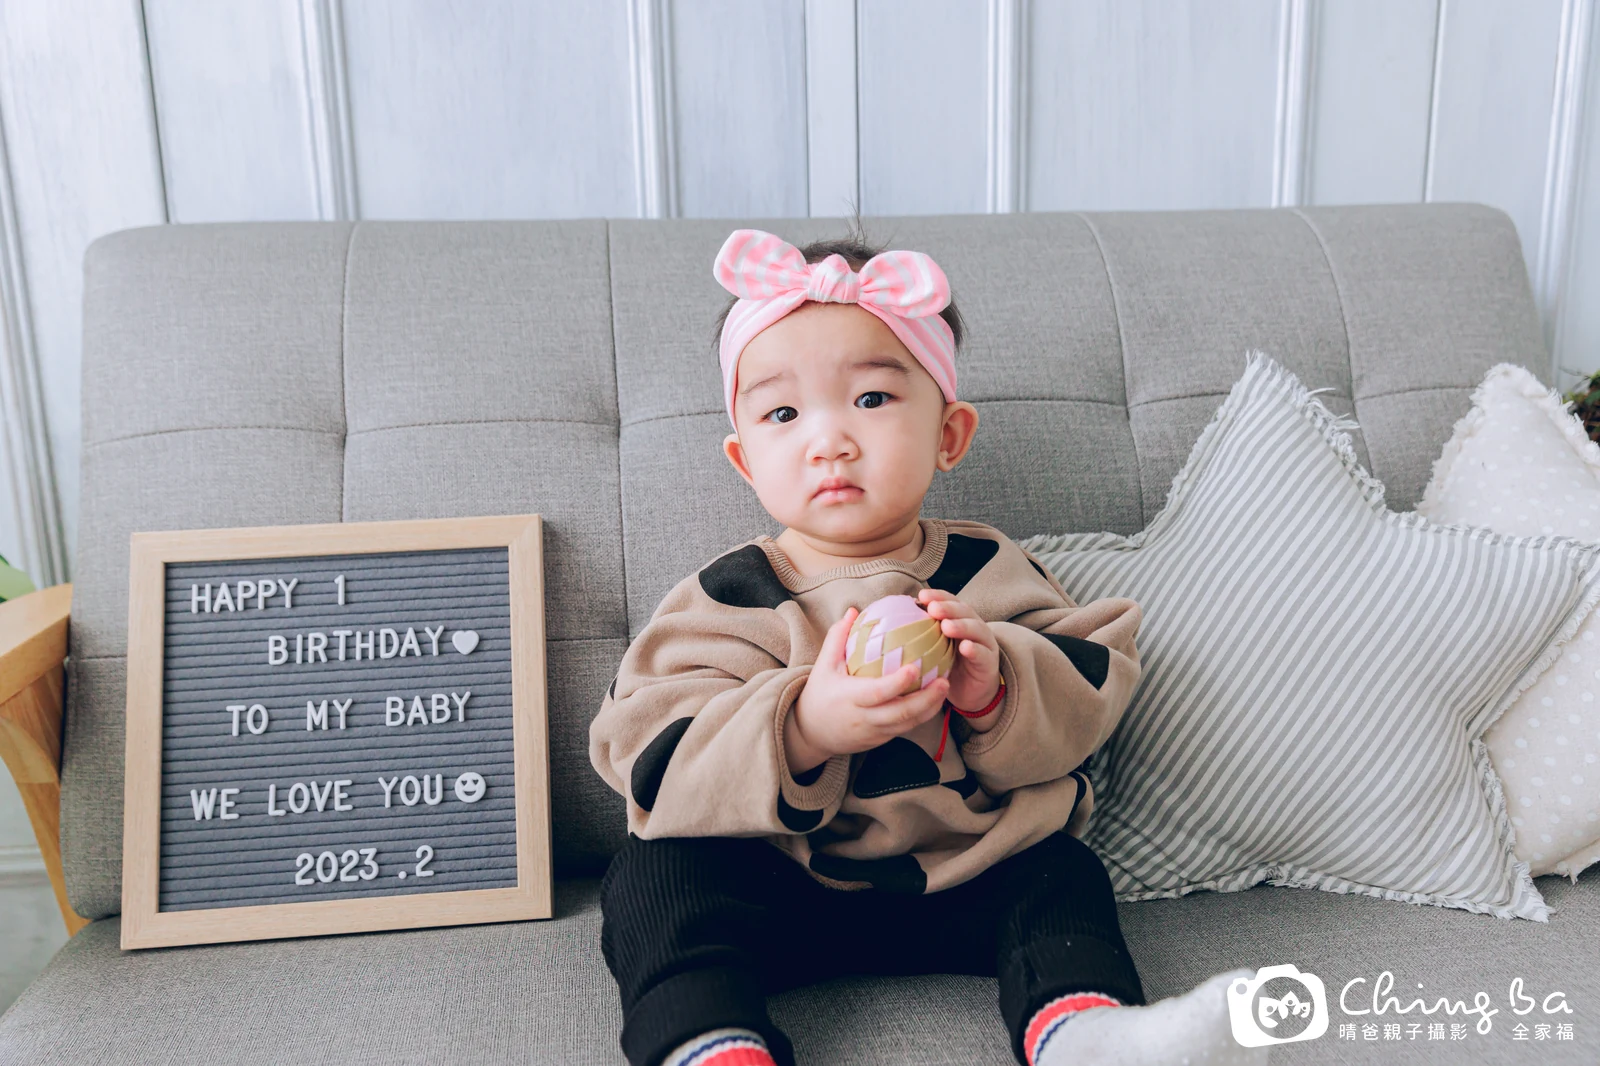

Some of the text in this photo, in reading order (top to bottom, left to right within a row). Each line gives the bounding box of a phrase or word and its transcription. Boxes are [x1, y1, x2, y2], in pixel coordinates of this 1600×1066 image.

[191, 574, 346, 614] HAPPY 1
[268, 625, 444, 665] BIRTHDAY
[226, 691, 471, 737] TO MY BABY
[190, 773, 443, 821] WE LOVE YOU
[295, 847, 379, 885] 2023
